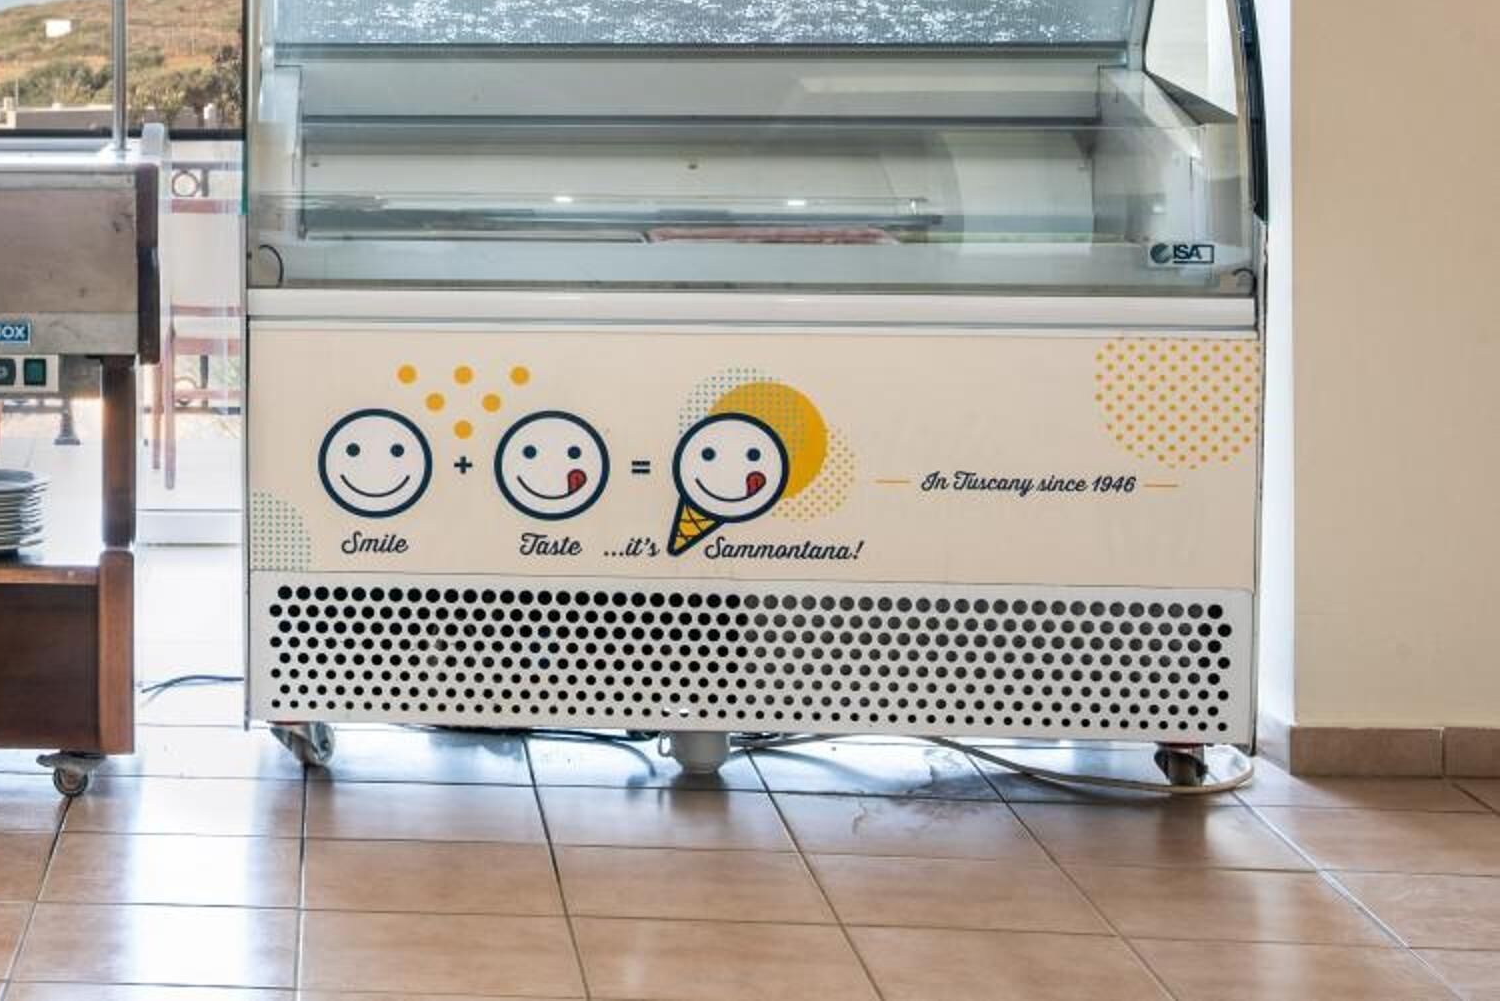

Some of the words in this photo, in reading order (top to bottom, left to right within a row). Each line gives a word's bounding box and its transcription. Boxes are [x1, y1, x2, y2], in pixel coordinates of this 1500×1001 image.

[1173, 244, 1202, 260] ISA
[920, 470, 950, 492] In
[953, 470, 1034, 498] Tuscany
[1036, 474, 1087, 493] since
[1091, 475, 1137, 493] 1946
[341, 531, 409, 555] Smile
[520, 532, 583, 556] Taste
[704, 535, 865, 561] Sammontana!
